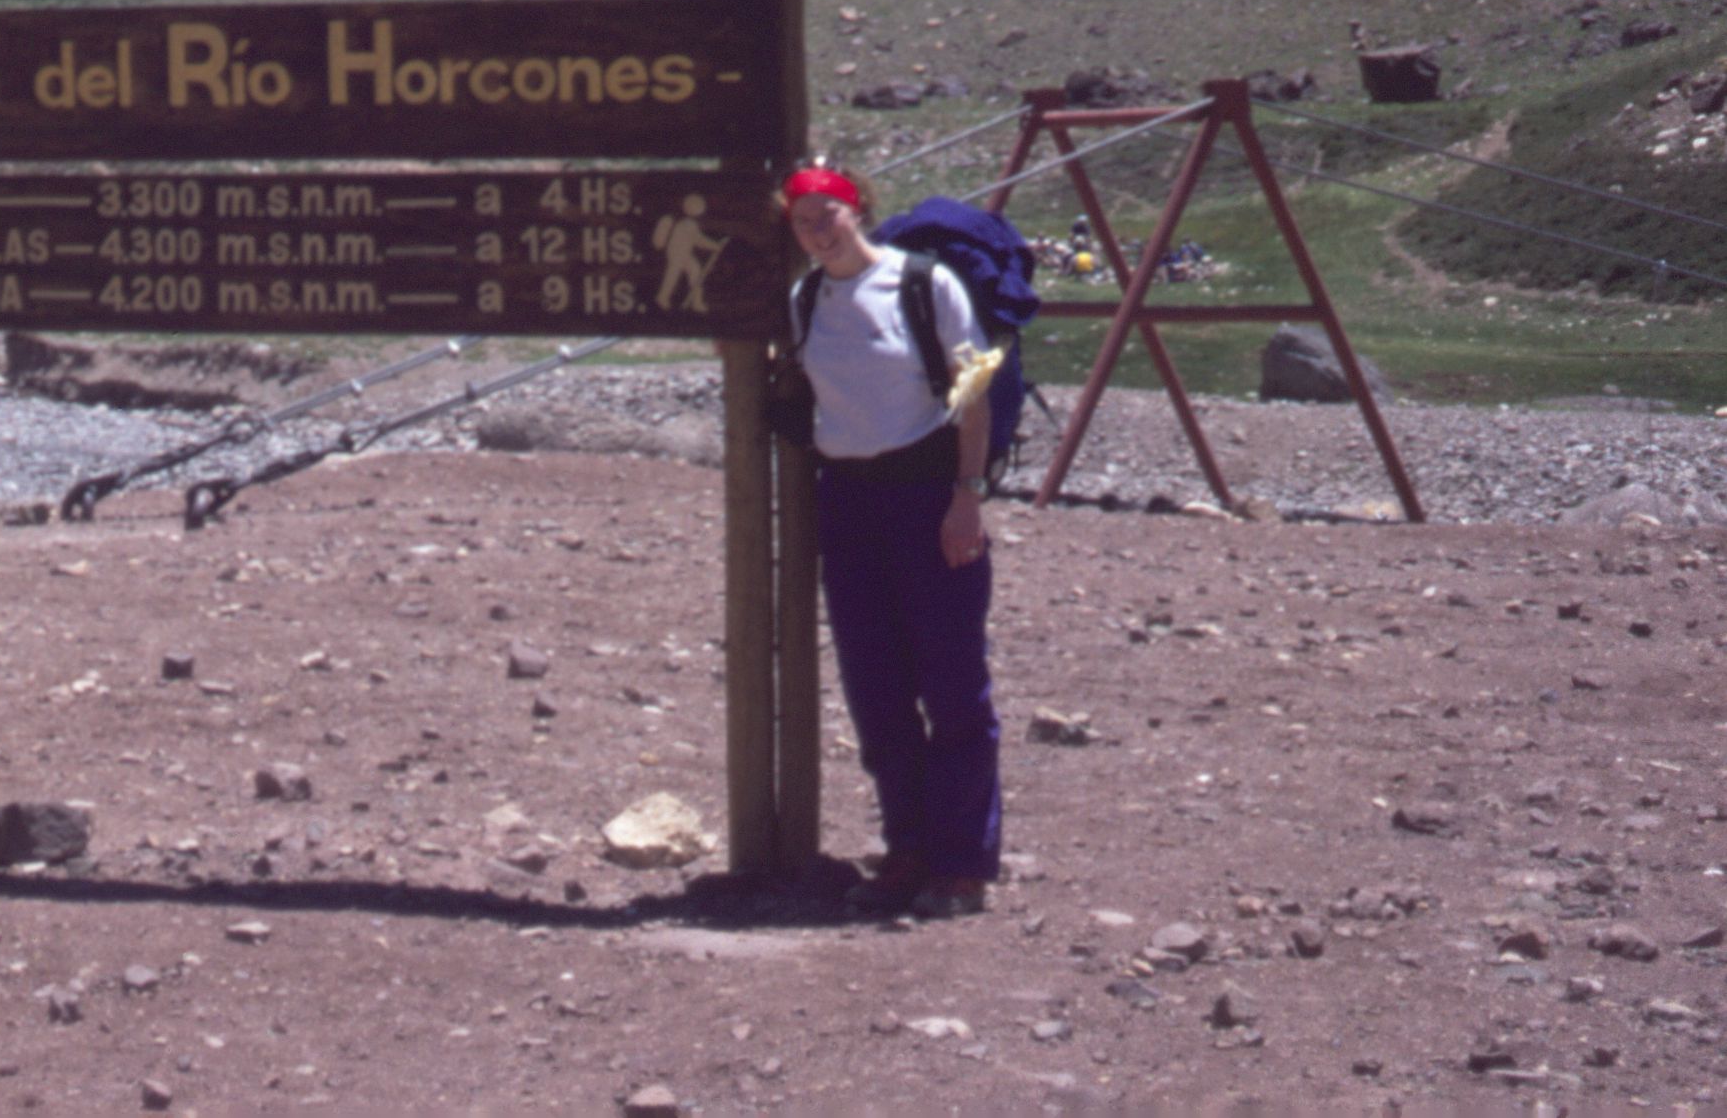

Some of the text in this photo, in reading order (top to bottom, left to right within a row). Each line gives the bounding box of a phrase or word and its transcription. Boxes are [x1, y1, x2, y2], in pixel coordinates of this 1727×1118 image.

[34, 38, 137, 109] del
[167, 21, 293, 108] Río
[327, 18, 696, 105] Horcones
[97, 179, 202, 218] 3.300
[216, 184, 383, 218] m.s.n.m.
[475, 183, 502, 216] a
[539, 178, 569, 216] 4
[580, 178, 642, 215] Hs.
[97, 226, 203, 265] 4.300
[217, 231, 383, 266] m.s.n.m.
[475, 231, 504, 264] a
[520, 225, 568, 264] 12
[582, 225, 642, 264] Hs.
[98, 274, 203, 313] 4.200
[218, 279, 385, 313] m.s.n.m.
[477, 279, 504, 313] a
[542, 274, 570, 313] 9
[583, 274, 646, 314] Hs.
